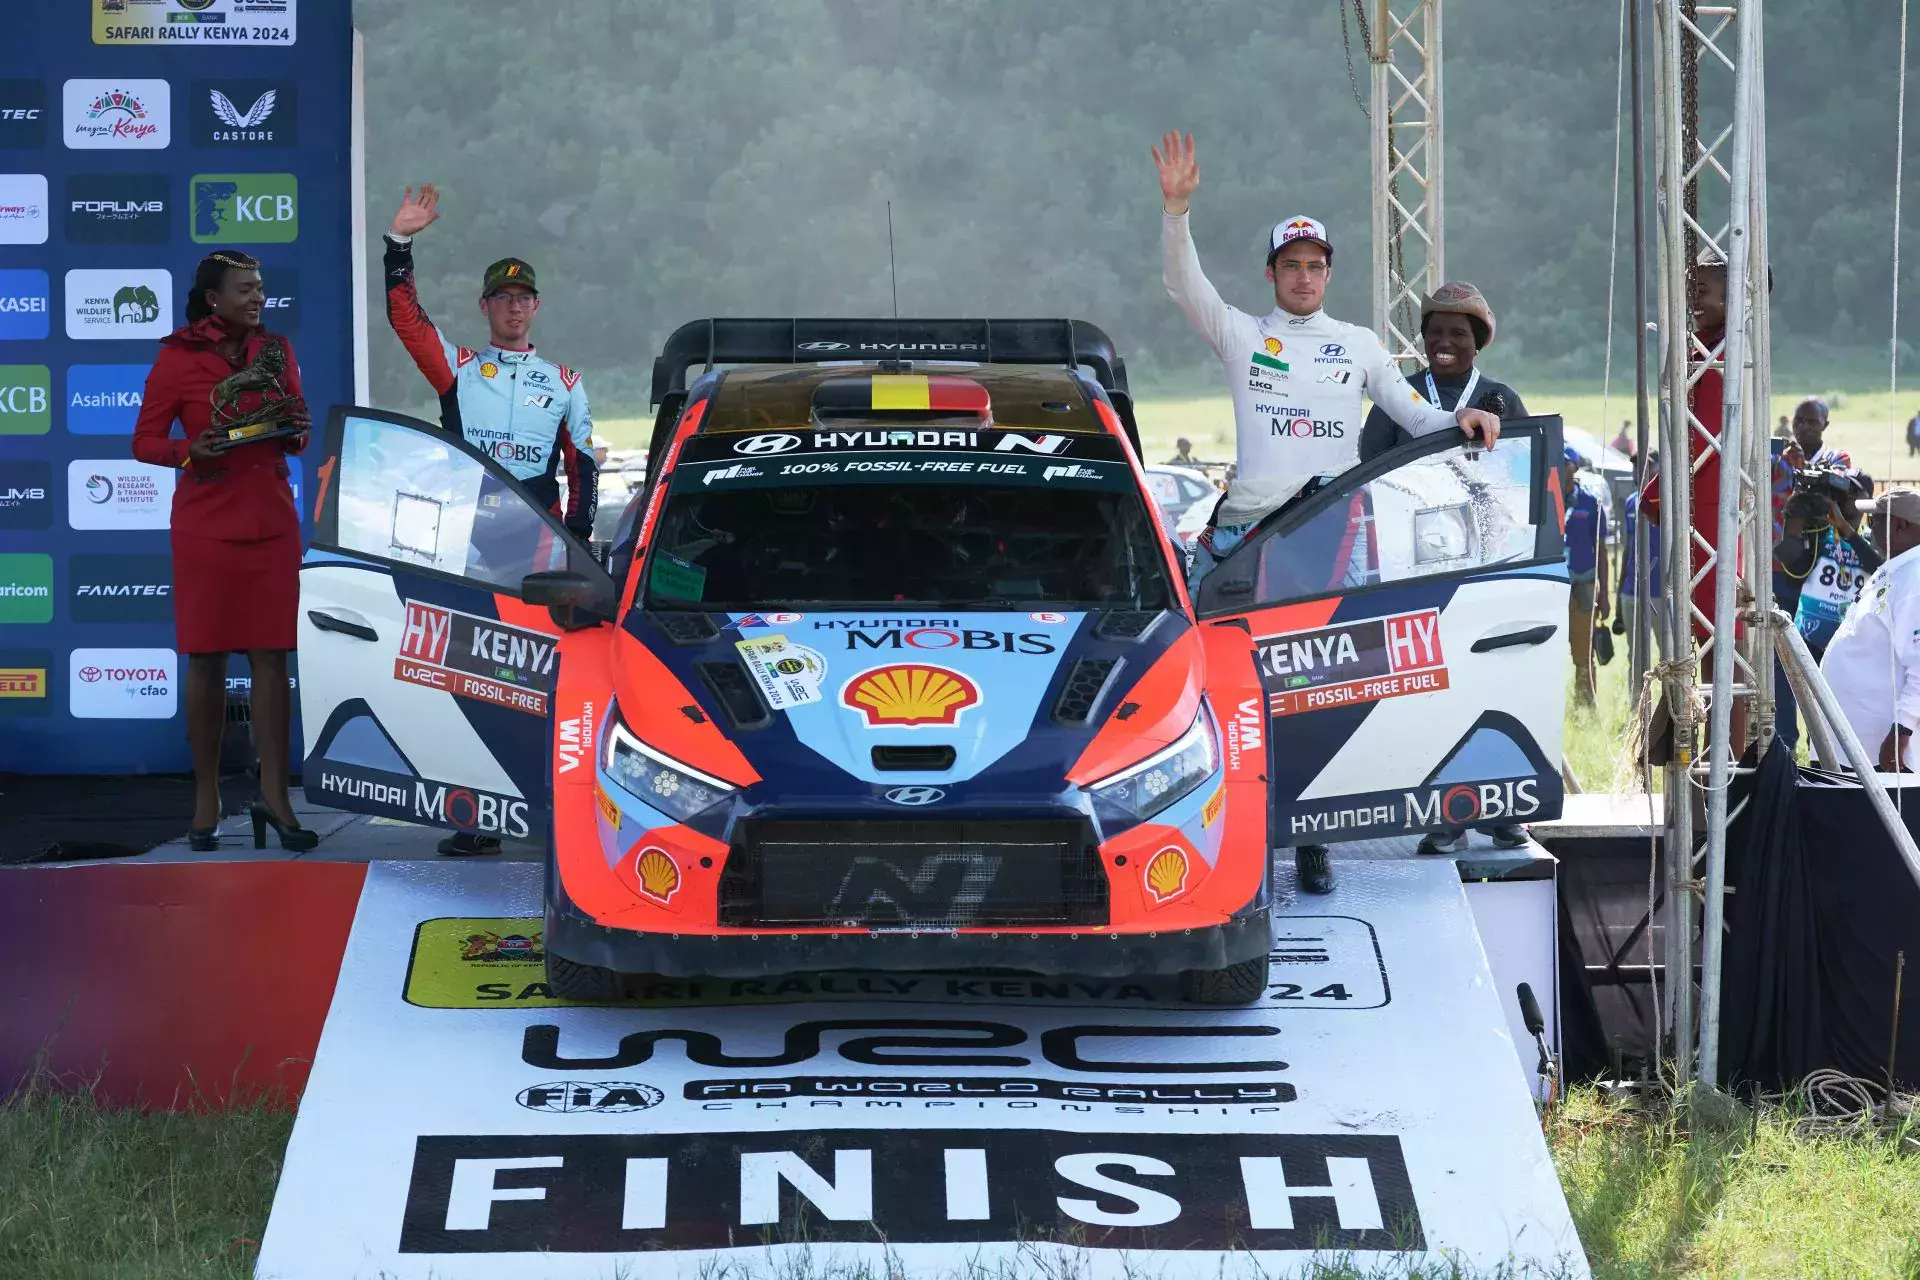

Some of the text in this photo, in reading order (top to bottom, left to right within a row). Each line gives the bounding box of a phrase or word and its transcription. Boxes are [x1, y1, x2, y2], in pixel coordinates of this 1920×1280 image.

[105, 27, 289, 40] SAFARI RALLY KENYA 2024
[112, 117, 159, 138] Kenya
[213, 132, 274, 141] CASTORE
[71, 201, 163, 212] FORUM8
[236, 195, 293, 222] KCB
[1283, 229, 1319, 241] Red Bull
[1314, 357, 1353, 365] HYUNDAI
[1249, 380, 1272, 390] LKQ
[71, 392, 142, 407] AsahiKA
[1255, 403, 1310, 417] HYUNDAI
[467, 428, 514, 442] HYUNDAI
[1271, 418, 1344, 438] MOBIS
[814, 430, 978, 448] HYUNDAI
[480, 440, 542, 464] MOBIS
[779, 461, 1028, 475] 100% FOSSIL-FREE FUEL
[0, 583, 48, 597] ricom
[77, 585, 169, 596] FANATEC
[402, 606, 447, 659] HY
[814, 620, 959, 629] HYUNDAI
[846, 629, 1056, 654] MOBIS
[1390, 619, 1439, 674] HY
[105, 669, 167, 681] TOYOTA
[140, 686, 168, 696] cfao
[464, 679, 542, 712] FOSSIL-FREE
[1307, 680, 1399, 707] FOSSIL-FREE
[1403, 674, 1440, 693] FUEL
[582, 702, 593, 748] HYUNDAI
[1228, 721, 1240, 770] HYUNDAI
[321, 772, 407, 807] HYUNDAI
[414, 781, 529, 838] MOBIS
[1403, 779, 1540, 828] MOBIS
[1291, 806, 1395, 834] HYUNDAI
[729, 977, 917, 997] RALLY
[946, 979, 1153, 1000] KENYA
[1268, 983, 1353, 1001] 24
[703, 1081, 1277, 1099] FIA WORLD RALLY
[701, 1099, 1281, 1116] CHAMPIONSHIP
[445, 1147, 1383, 1231] FINISH
